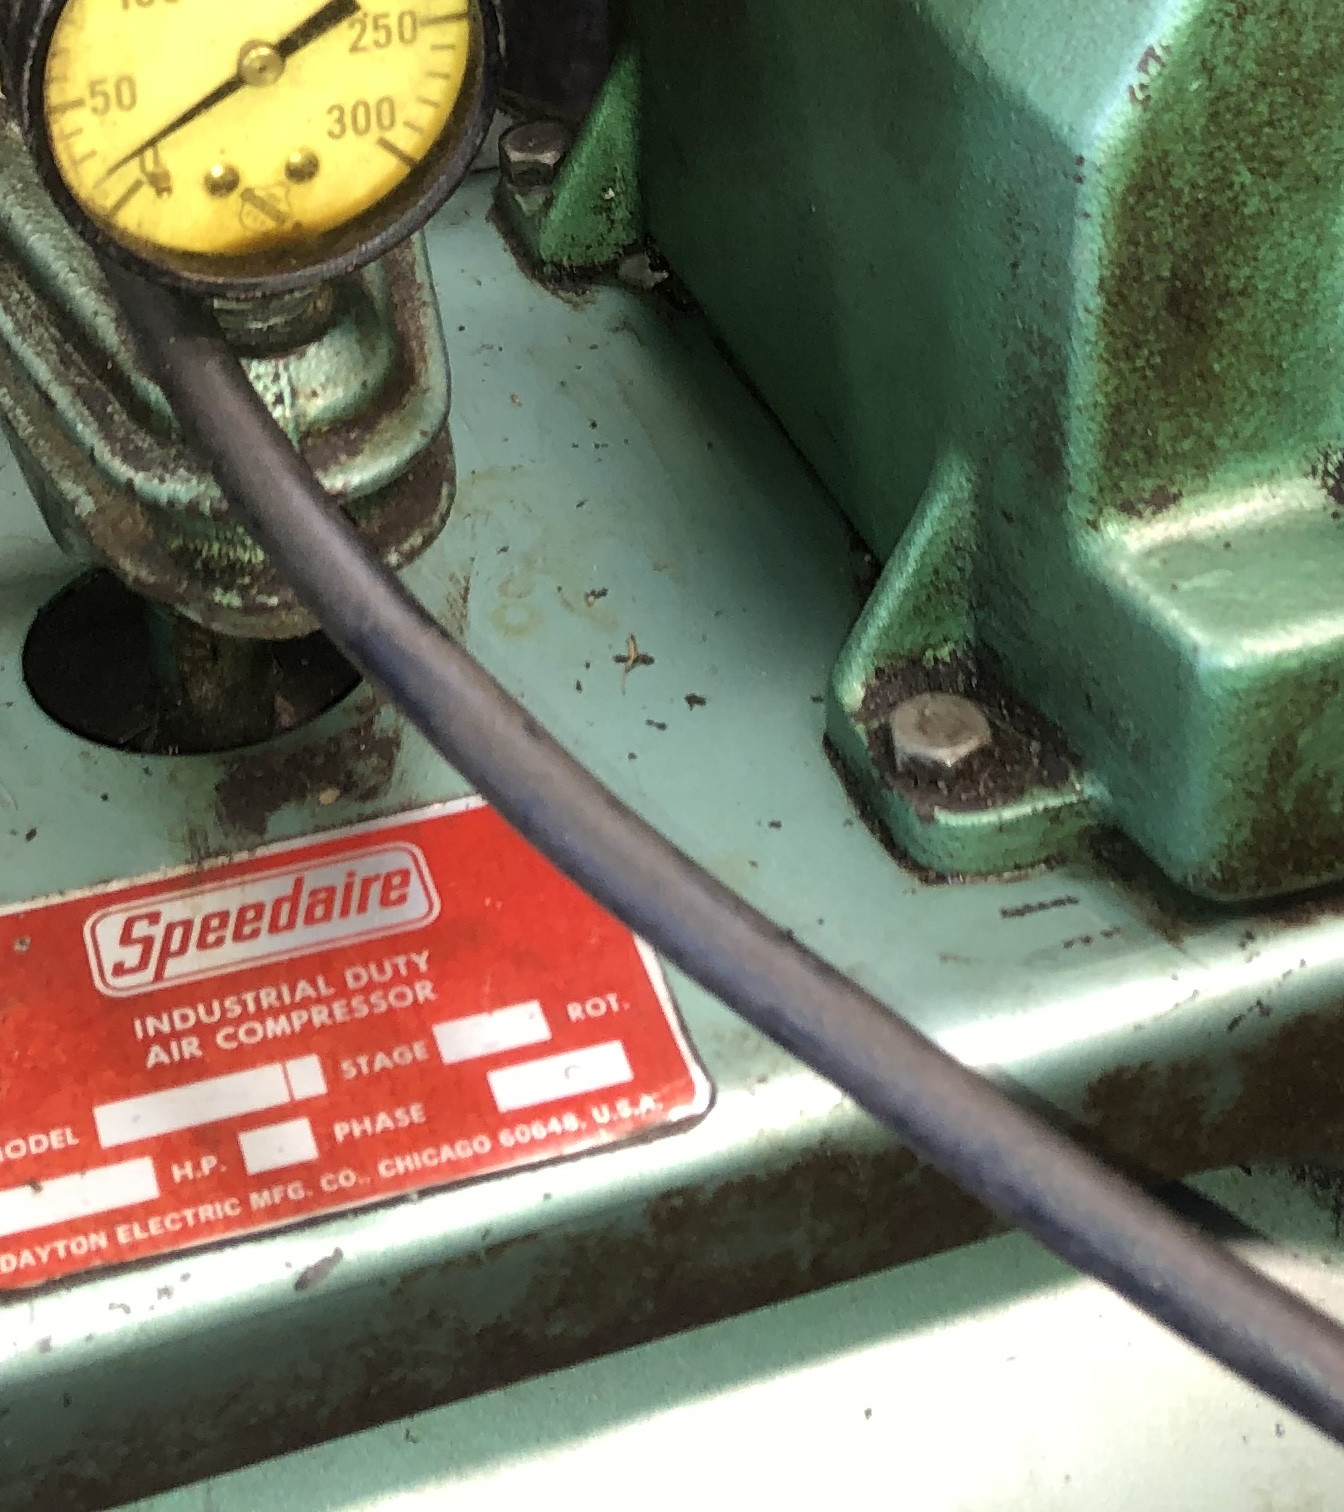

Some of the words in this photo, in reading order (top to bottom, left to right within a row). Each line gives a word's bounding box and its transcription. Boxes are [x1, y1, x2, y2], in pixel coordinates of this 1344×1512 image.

[347, 10, 419, 54] 250
[87, 76, 138, 117] 50
[326, 97, 397, 140] 300
[110, 861, 412, 983] Speedaire
[133, 974, 336, 1040] INDUSTRIAL
[343, 950, 430, 990] DUTY
[566, 993, 631, 1023] ROT.
[145, 1036, 203, 1069] AIR
[215, 979, 438, 1050] COMPRESSOR
[340, 1040, 429, 1080] STAGE
[333, 1102, 426, 1144] PHASE
[115, 1198, 242, 1245] ELECTRIC
[250, 1180, 314, 1210] MFG.
[377, 1134, 492, 1179] CHICAGO
[171, 1155, 227, 1184] H.P.
